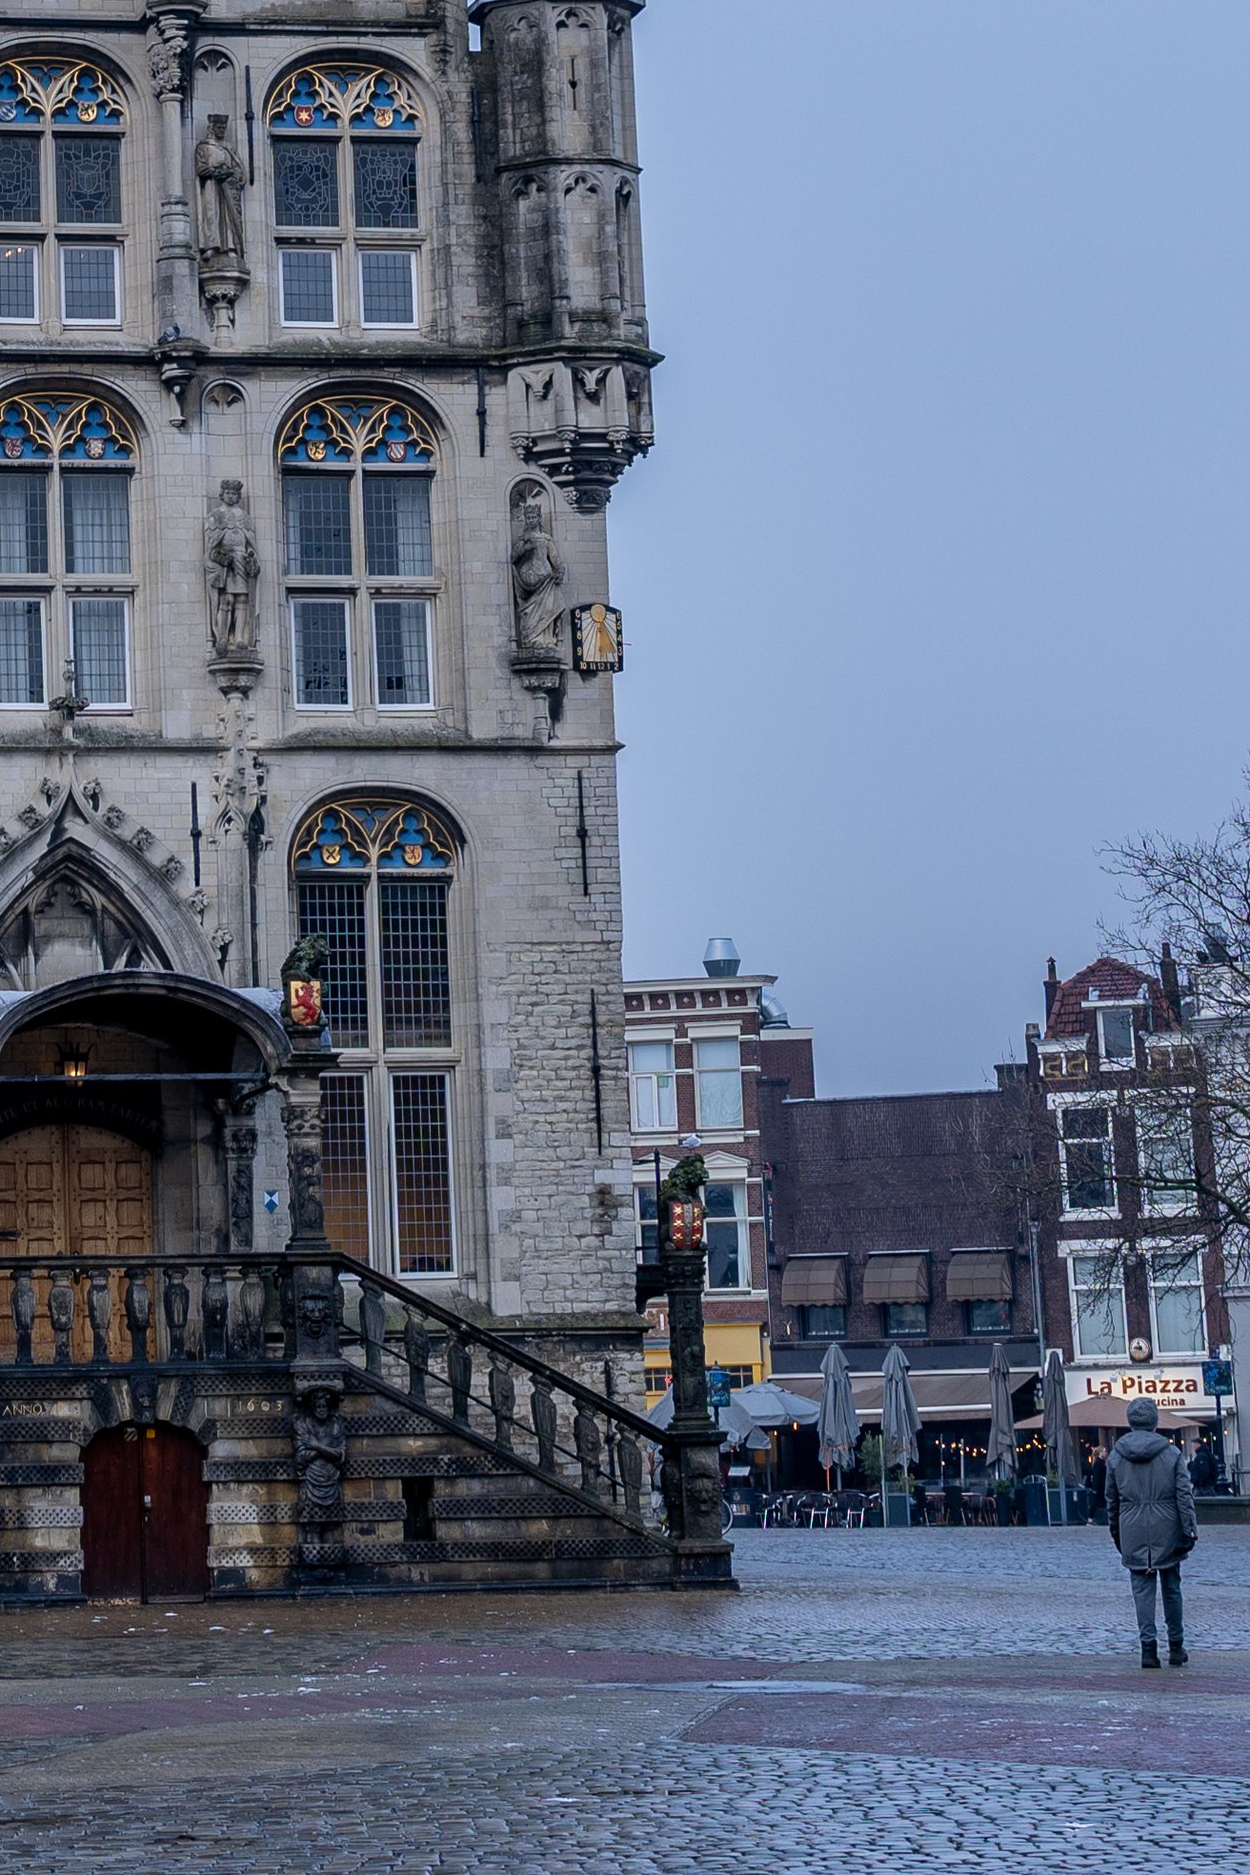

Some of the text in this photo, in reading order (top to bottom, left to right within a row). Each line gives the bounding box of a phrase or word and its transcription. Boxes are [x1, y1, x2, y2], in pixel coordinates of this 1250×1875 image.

[1086, 1375, 1199, 1396] La Piazza
[1154, 1396, 1186, 1407] ucina
[2, 1402, 43, 1417] ANNO
